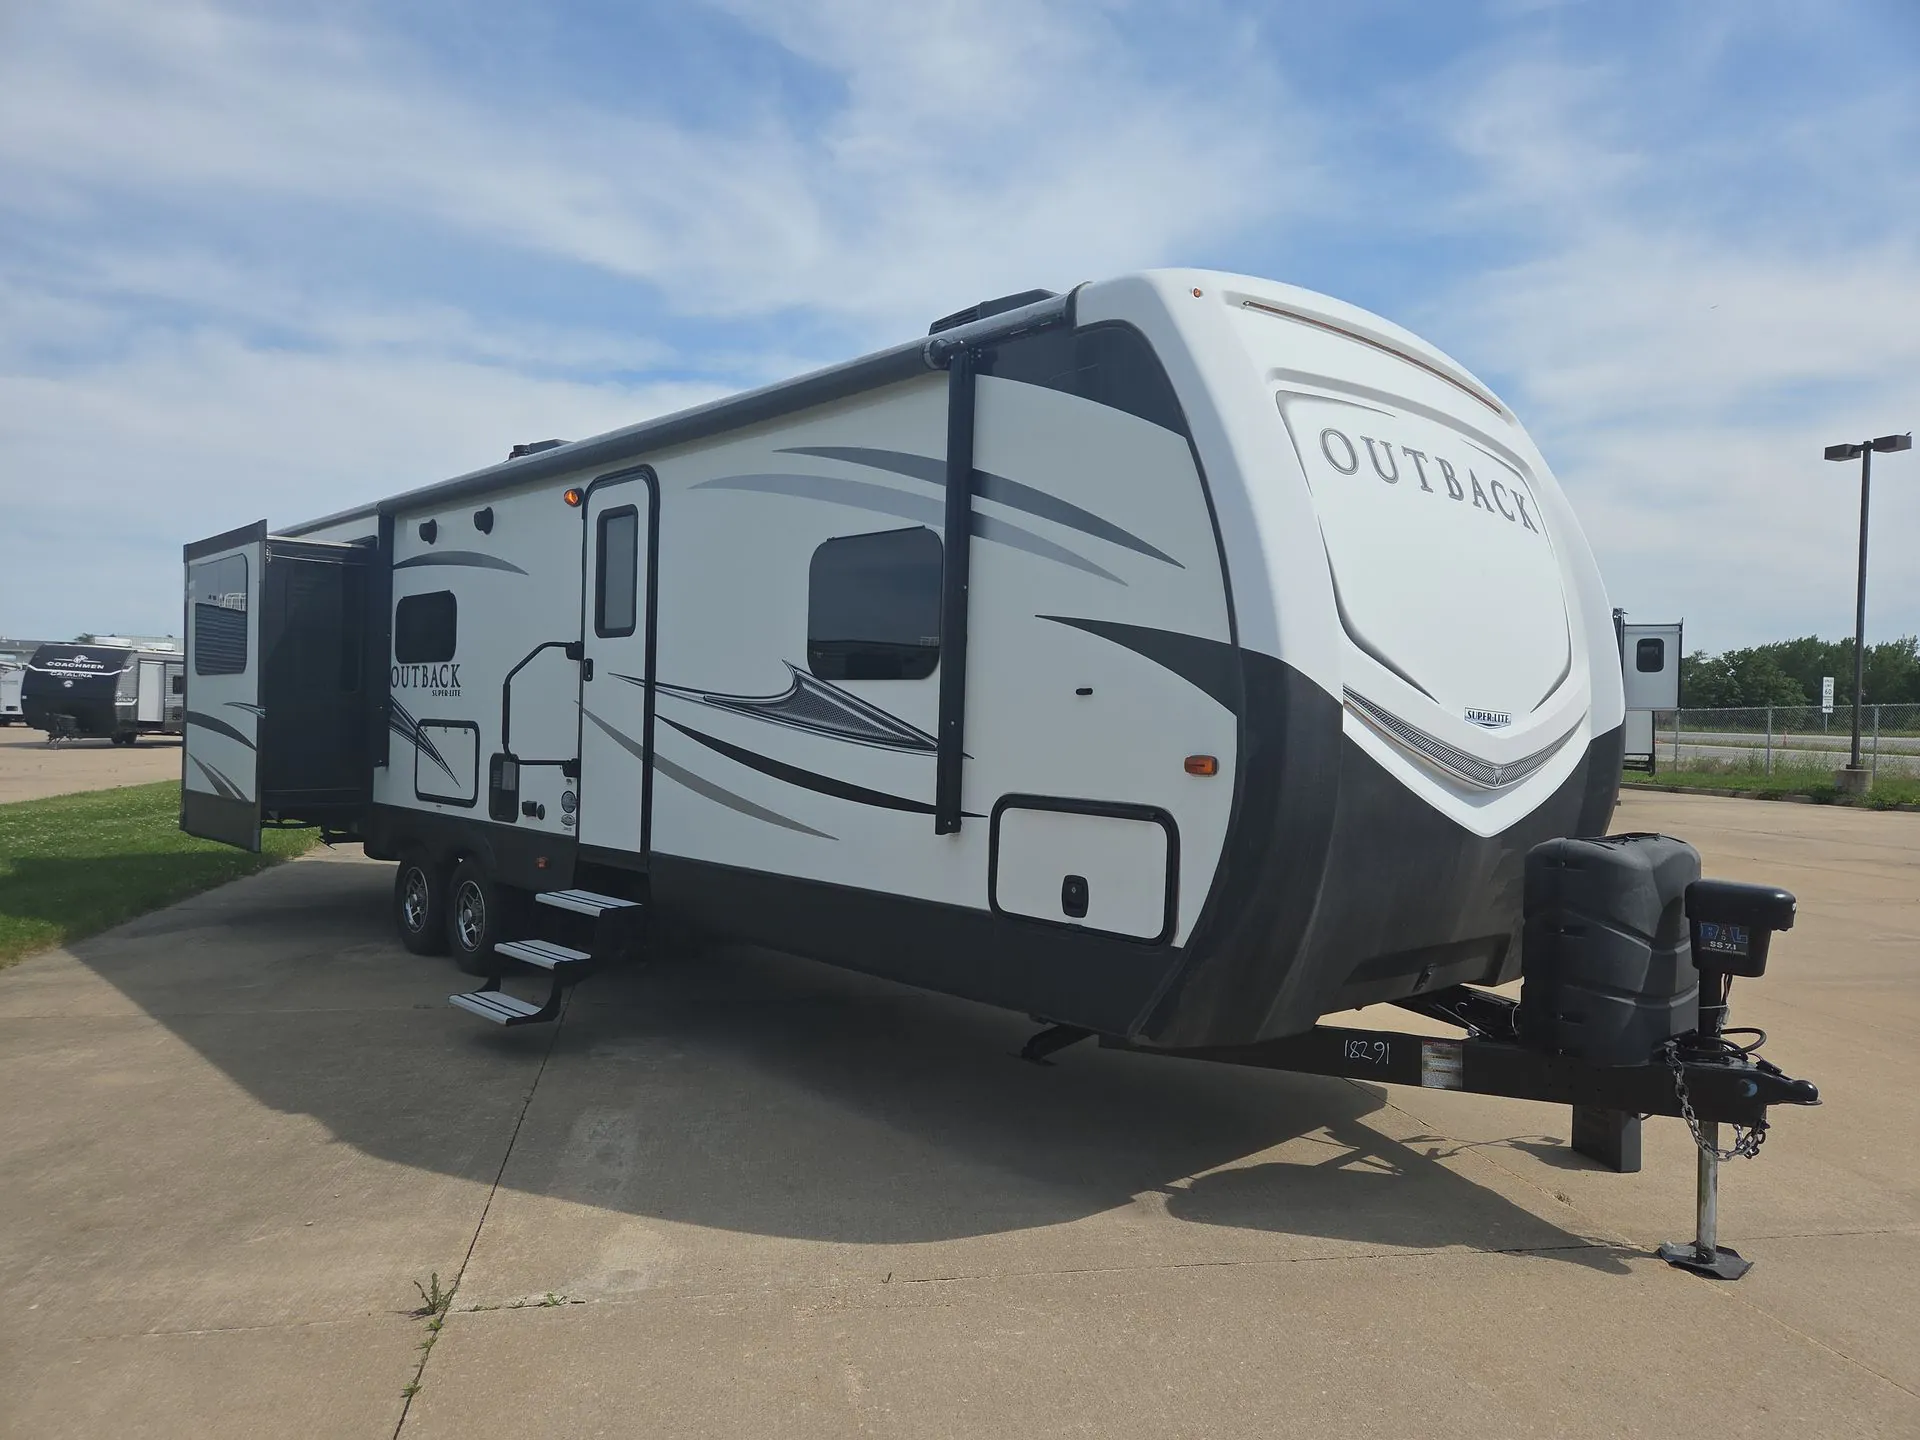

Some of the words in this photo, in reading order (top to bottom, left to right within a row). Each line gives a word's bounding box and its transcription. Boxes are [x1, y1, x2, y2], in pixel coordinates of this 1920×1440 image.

[1319, 427, 1539, 535] OUTBACK
[45, 661, 105, 670] COACHMEN
[391, 664, 461, 688] OUTBACK
